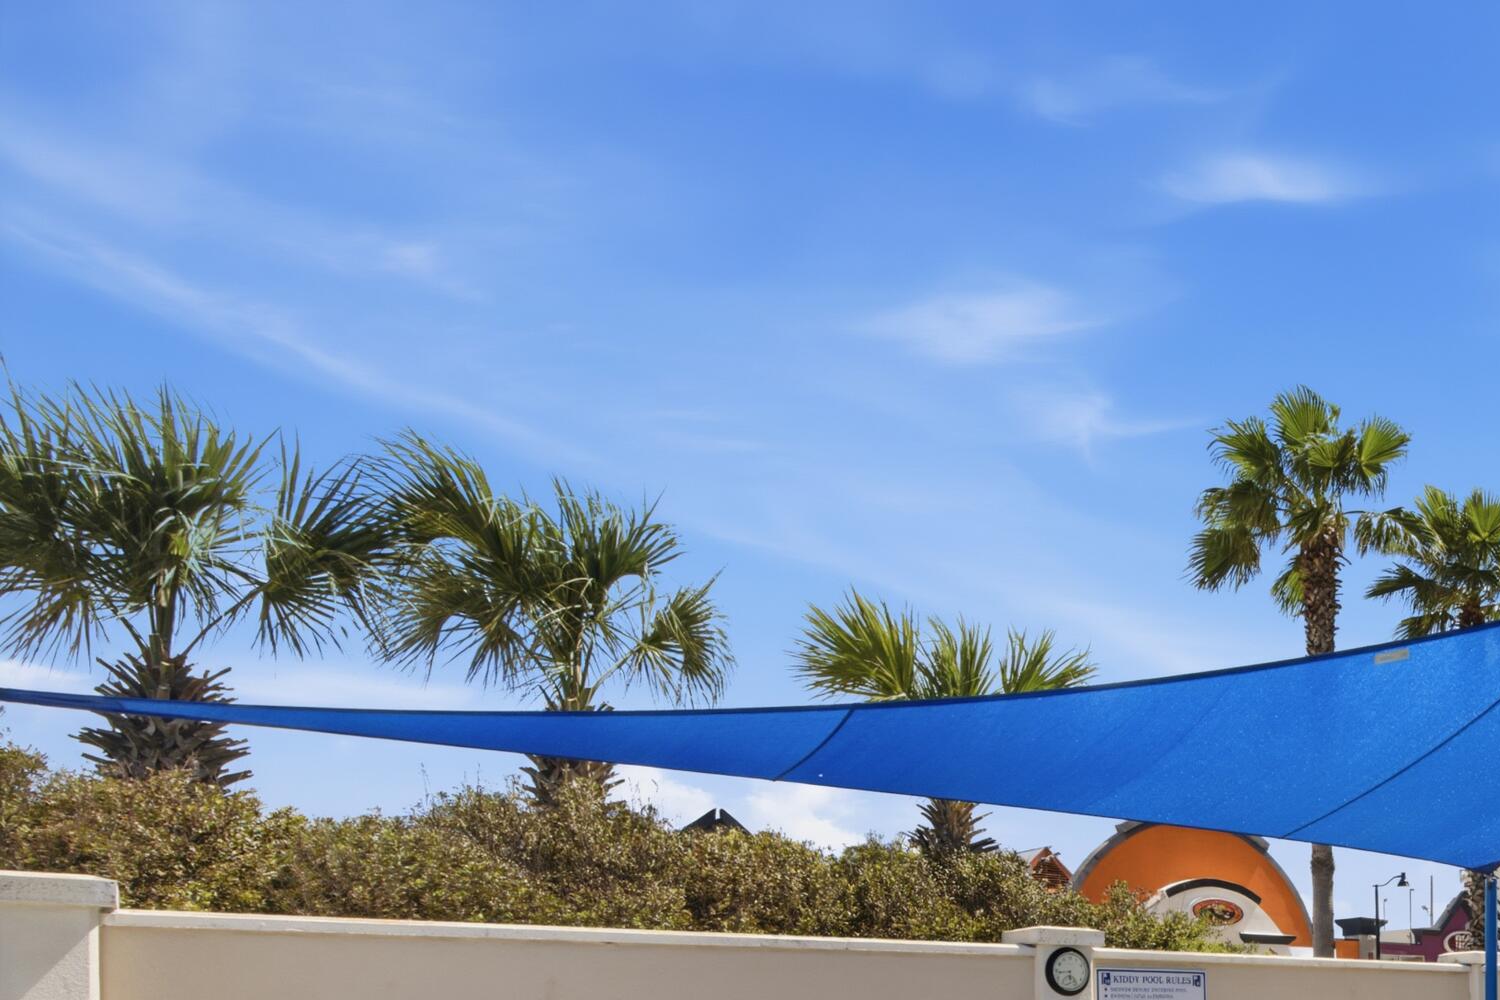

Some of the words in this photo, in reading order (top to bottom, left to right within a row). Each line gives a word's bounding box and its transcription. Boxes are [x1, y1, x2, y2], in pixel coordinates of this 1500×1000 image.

[1113, 975, 1140, 984] KIDDY
[1142, 976, 1164, 984] POOL
[1165, 976, 1191, 985] RULES
